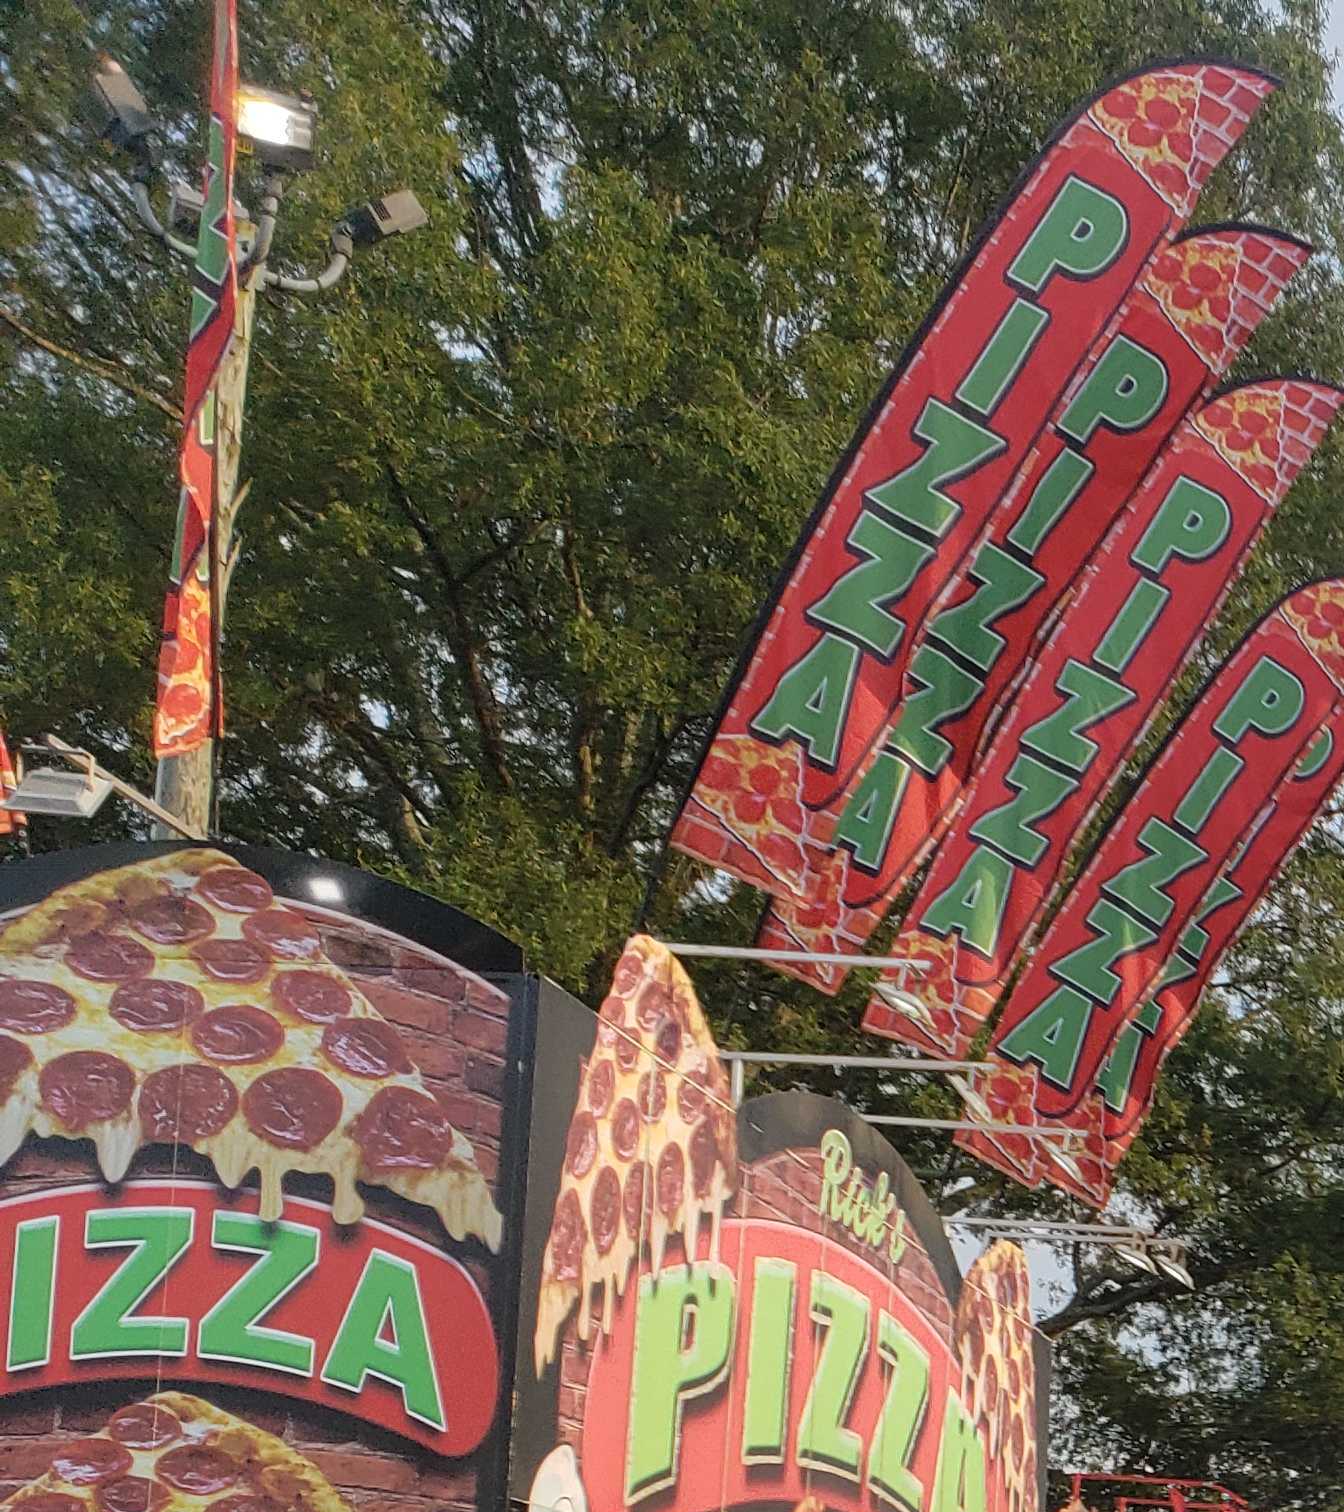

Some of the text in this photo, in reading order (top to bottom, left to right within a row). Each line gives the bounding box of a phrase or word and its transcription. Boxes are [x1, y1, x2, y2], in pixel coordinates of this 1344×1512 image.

[751, 176, 1128, 767] PIZZA
[833, 340, 1168, 871] PIZZA
[921, 477, 1231, 957] PIZZA
[997, 657, 1303, 1089] PIZZA
